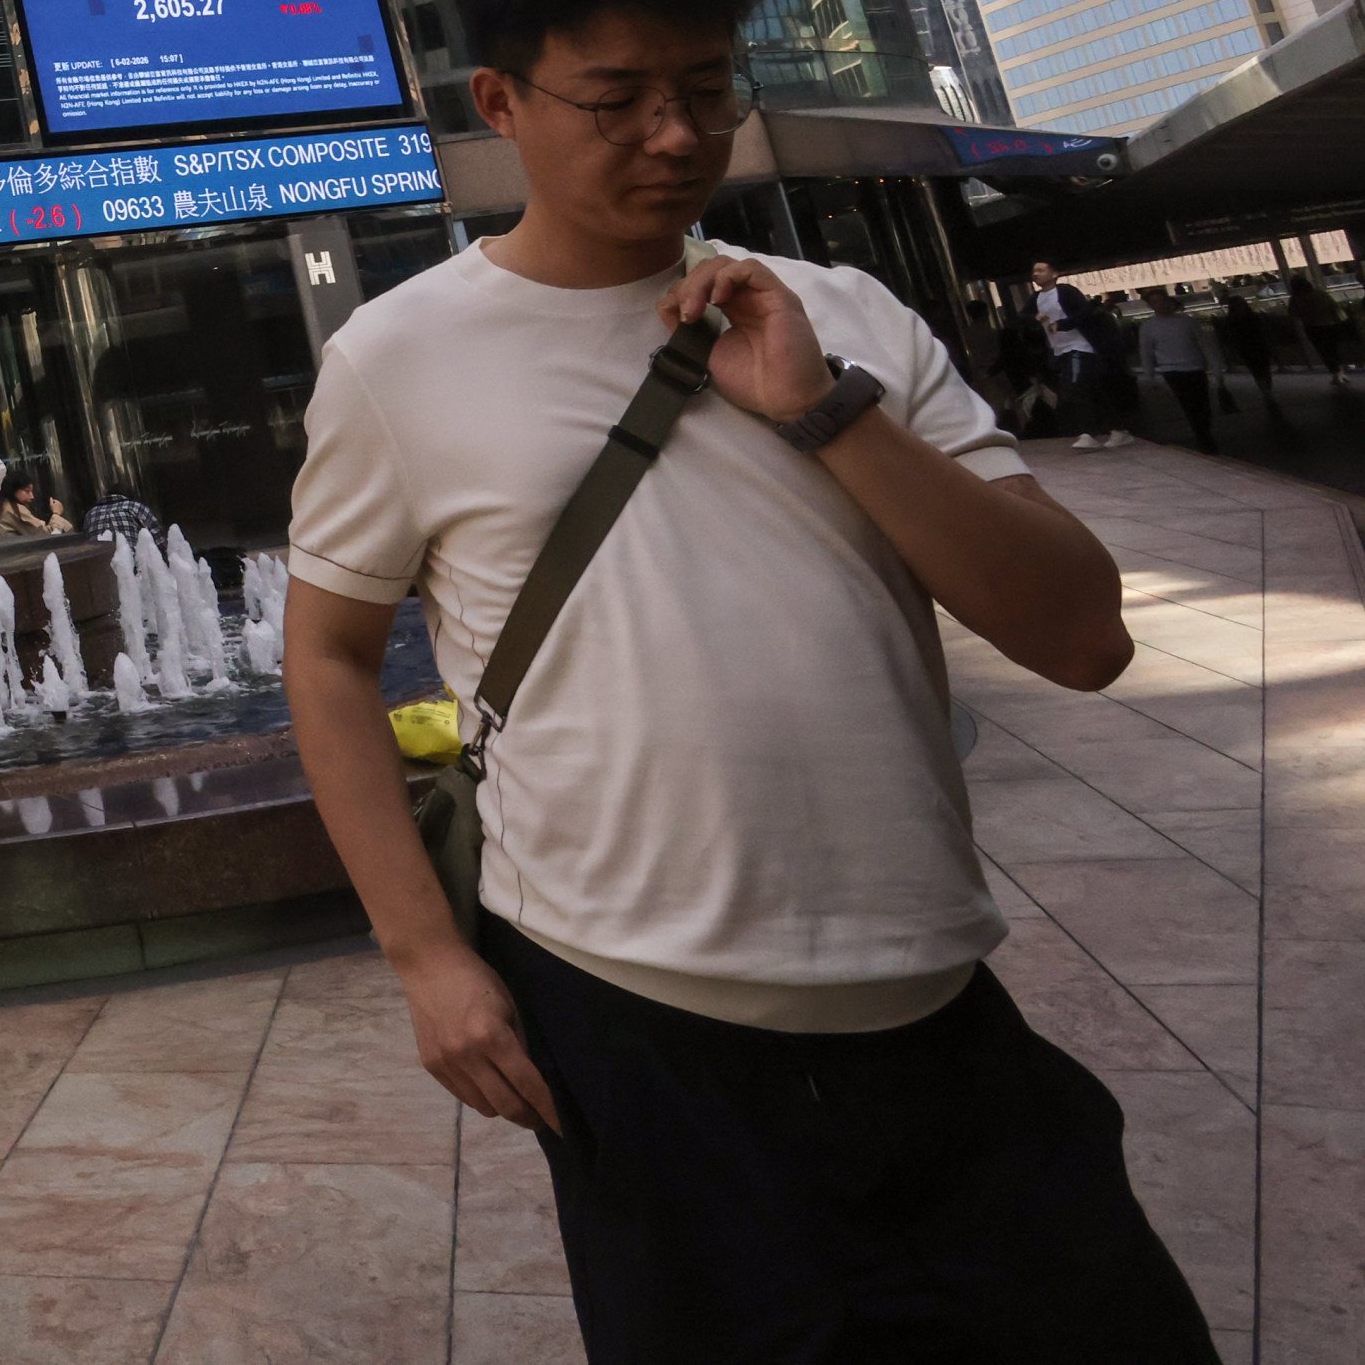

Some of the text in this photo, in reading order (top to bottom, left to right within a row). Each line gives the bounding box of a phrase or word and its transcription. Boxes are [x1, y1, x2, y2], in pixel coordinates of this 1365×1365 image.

[70, 60, 103, 70] UPDATE:
[115, 56, 149, 66] 6-02-2026
[159, 54, 178, 63] 15:07
[174, 148, 265, 176] S&P/TSX
[268, 137, 390, 167] COMPOSITE
[26, 204, 66, 229] -2.6
[102, 197, 165, 223] 09633
[173, 183, 272, 219] 農夫山泉
[279, 176, 367, 204] NONGFU
